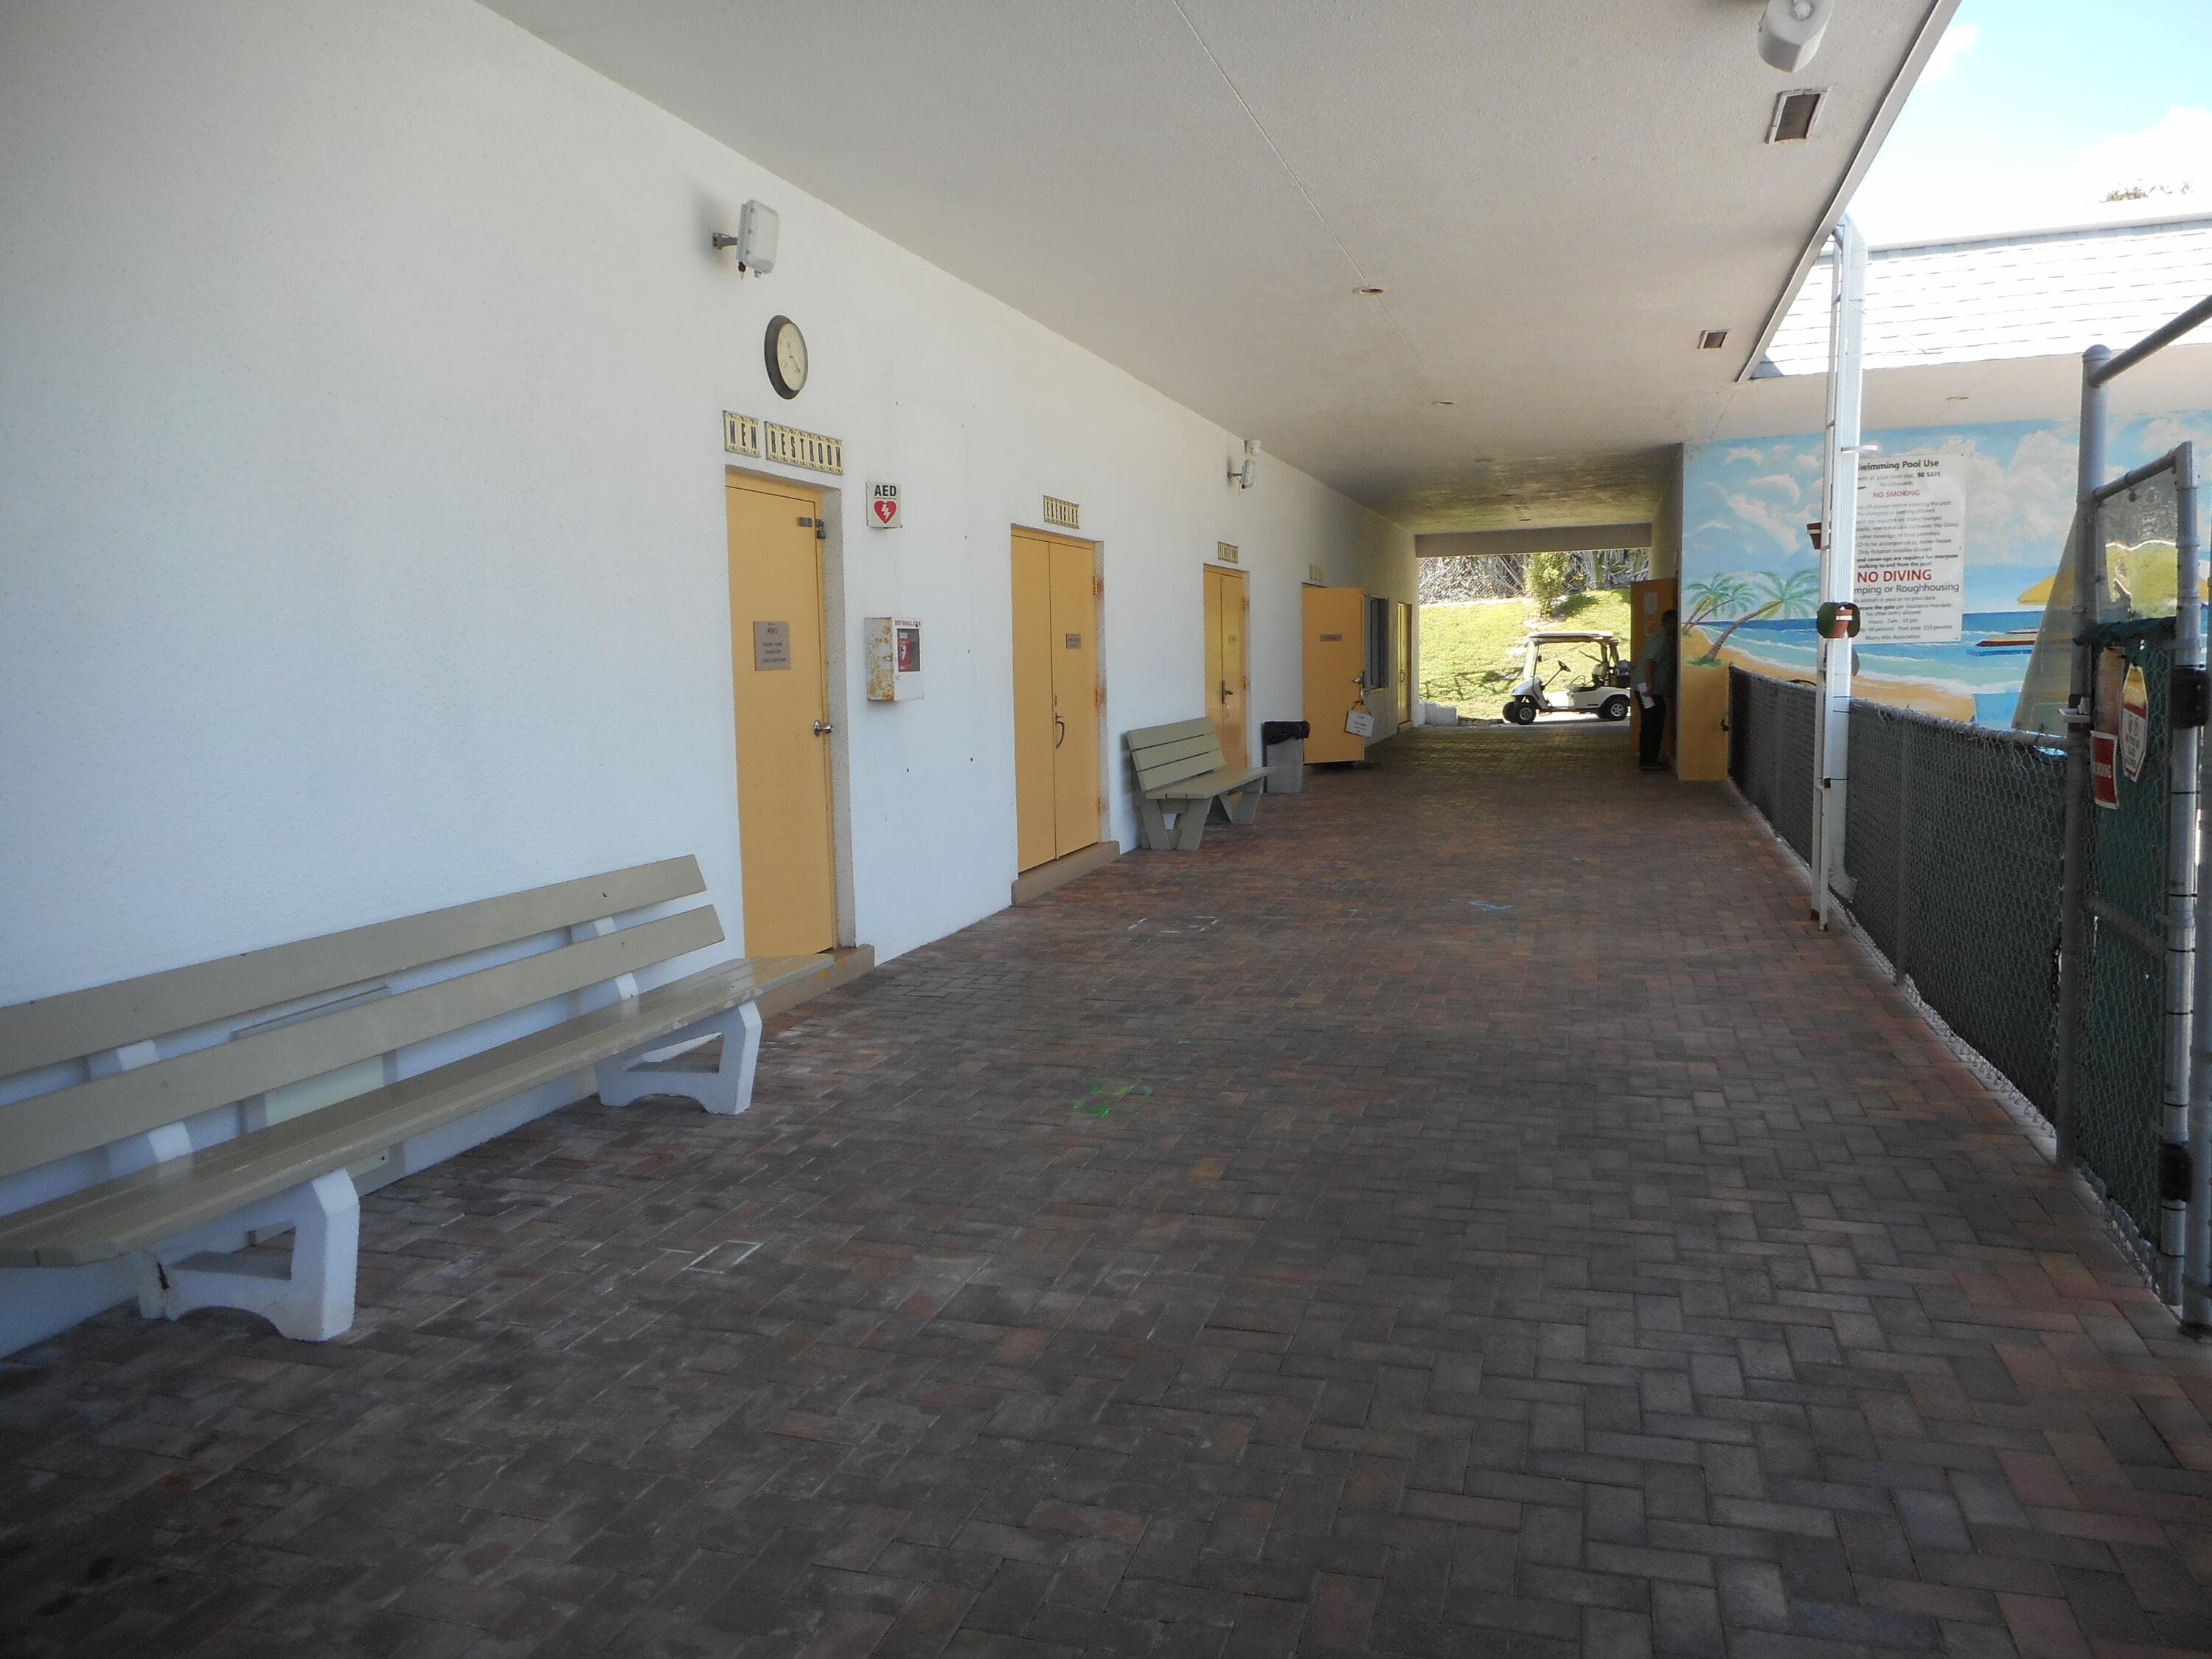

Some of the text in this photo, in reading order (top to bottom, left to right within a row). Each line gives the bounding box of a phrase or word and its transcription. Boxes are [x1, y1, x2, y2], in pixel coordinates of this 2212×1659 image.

[729, 420, 841, 468] MEN RESTROOM
[1902, 460, 1921, 468] Pool
[1924, 459, 1939, 467] Use
[874, 484, 897, 496] AED
[1886, 490, 1920, 498] SMOKING
[1857, 569, 1932, 582] NO DIVING
[1854, 585, 1882, 596] mping
[1896, 582, 1959, 594] Roughhousing
